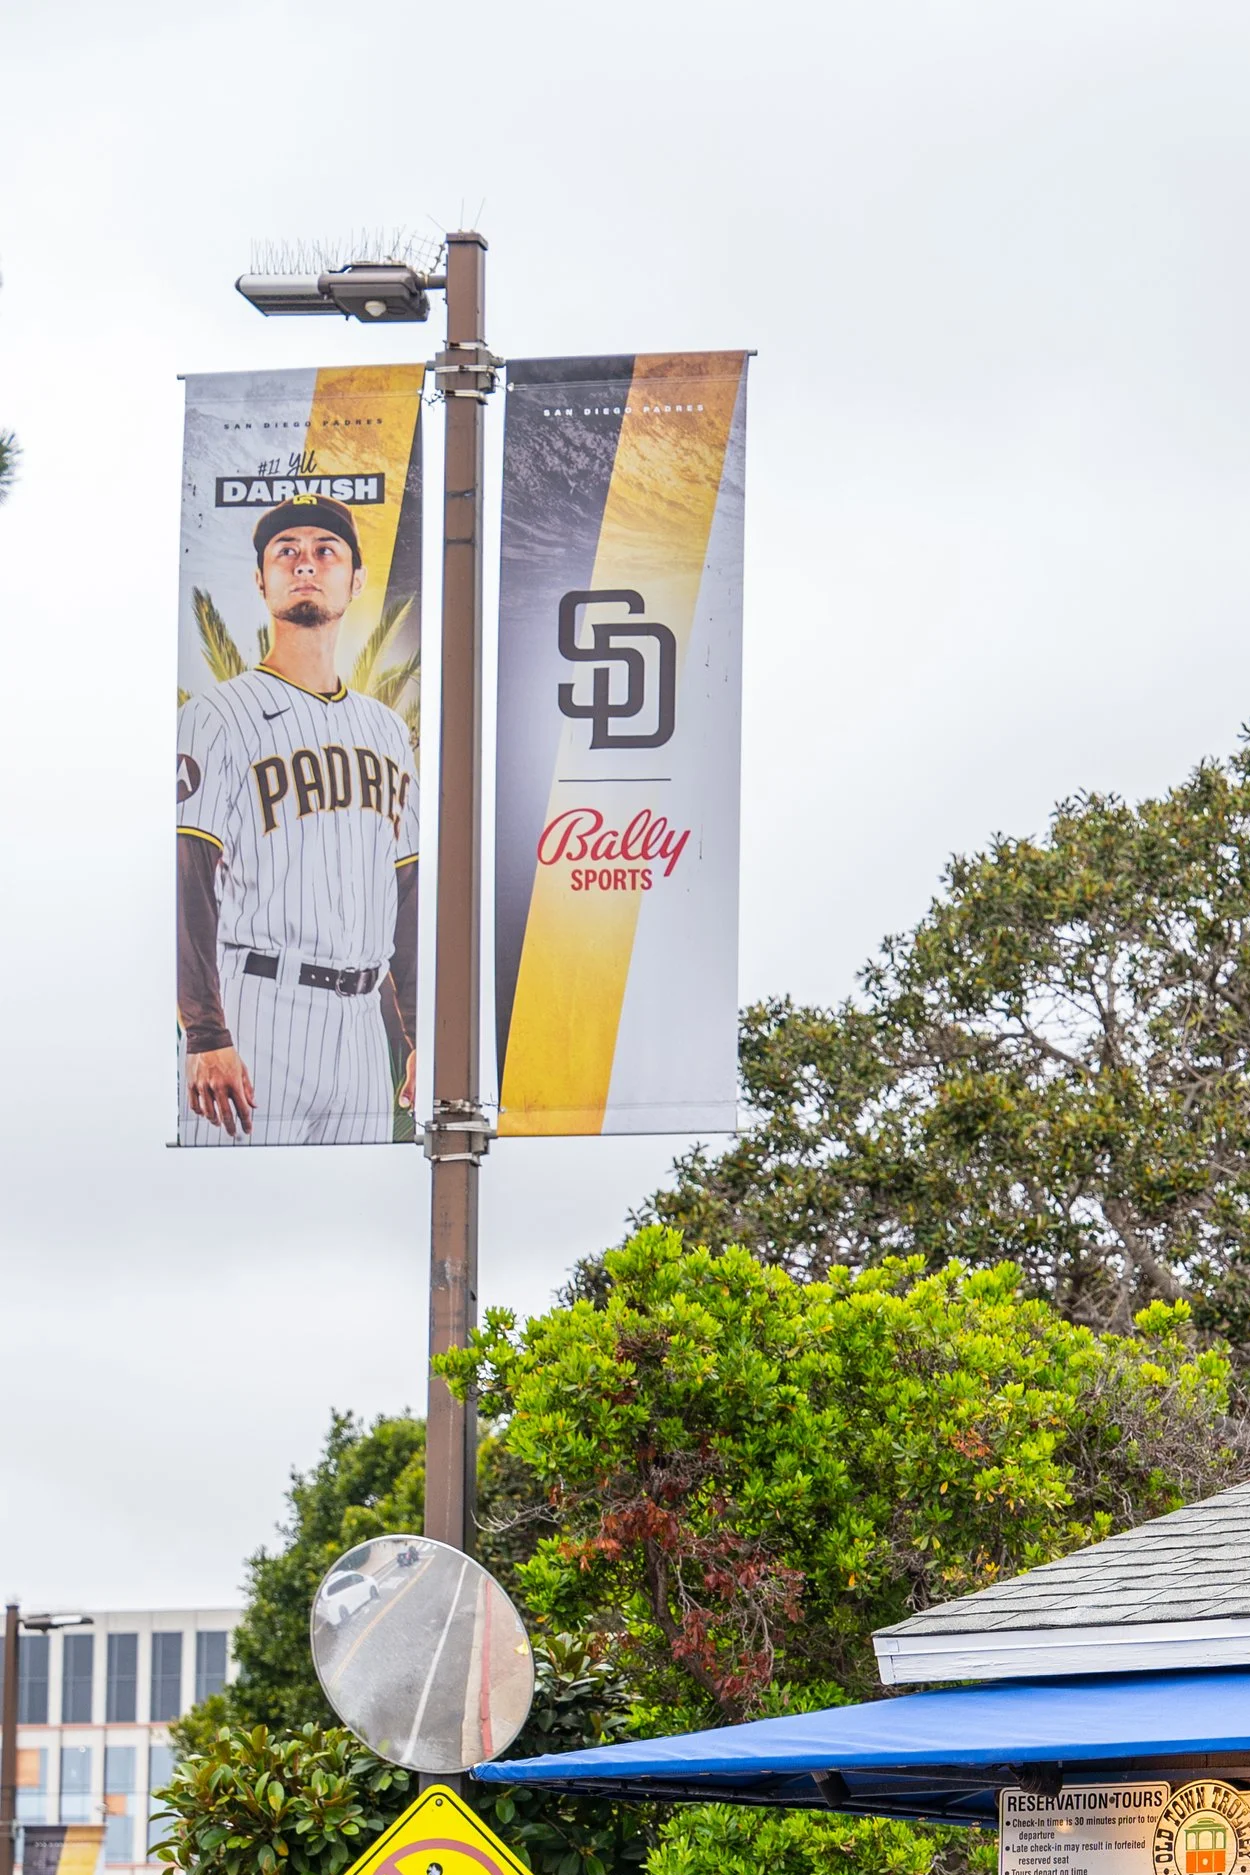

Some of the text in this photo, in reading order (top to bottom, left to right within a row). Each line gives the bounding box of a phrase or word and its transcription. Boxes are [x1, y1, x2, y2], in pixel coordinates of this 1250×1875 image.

[543, 404, 704, 417] SAN DIEGO PADRES
[322, 418, 383, 427] PADRES
[258, 458, 281, 476] #11
[222, 477, 378, 503] DARVISH
[558, 589, 676, 749] SD
[537, 808, 691, 877] Bally
[571, 869, 653, 891] SPORTS
[1007, 1791, 1163, 1812] RESERVATION TOURS
[1164, 1786, 1206, 1827] TOWN
[1012, 1818, 1045, 1828] Check-In
[1047, 1818, 1064, 1827] time
[1066, 1817, 1073, 1826] is
[1074, 1817, 1084, 1826] 30
[1086, 1816, 1117, 1826] minutes
[1118, 1816, 1136, 1827] prior
[1138, 1815, 1145, 1824] to
[1018, 1832, 1055, 1841] departure
[1155, 1828, 1174, 1863] OLD
[1012, 1840, 1145, 1855] Late check-in may result in forfeited
[1018, 1855, 1069, 1865] reserved seat
